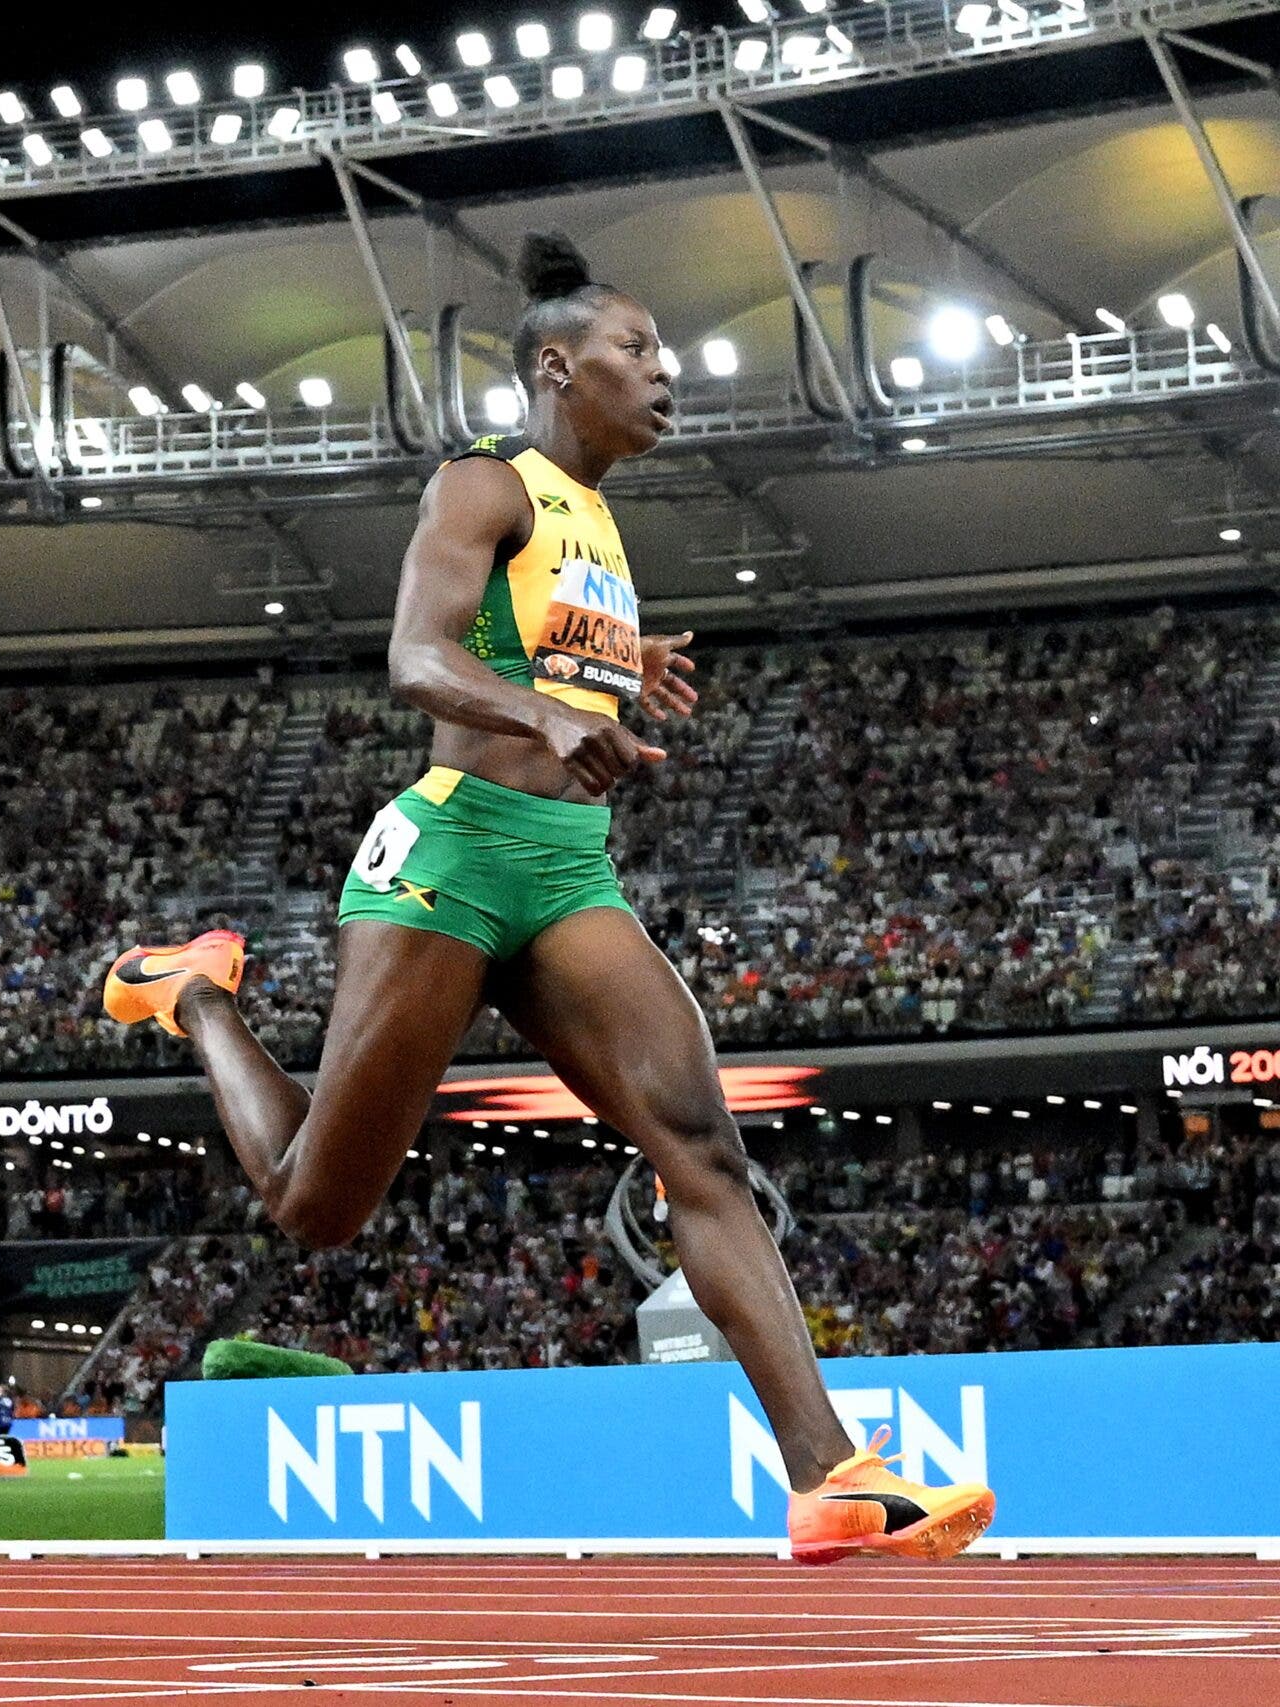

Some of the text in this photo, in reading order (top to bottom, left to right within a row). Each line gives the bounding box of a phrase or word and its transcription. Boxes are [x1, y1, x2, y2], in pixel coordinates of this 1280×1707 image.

[583, 567, 637, 619] NTN
[1230, 1050, 1280, 1083] 20
[38, 1419, 88, 1437] NTN
[268, 1401, 483, 1524] NTN
